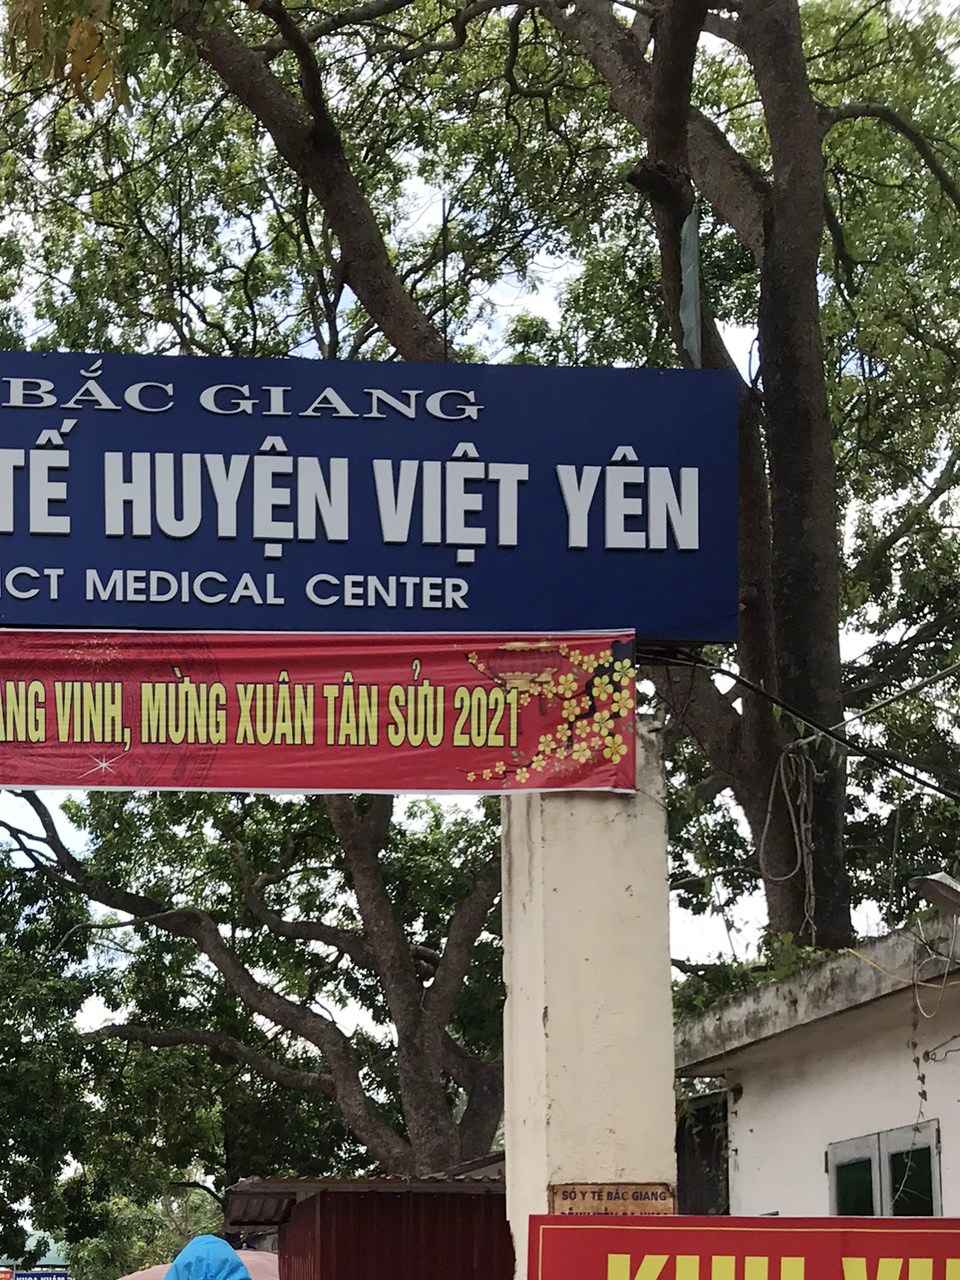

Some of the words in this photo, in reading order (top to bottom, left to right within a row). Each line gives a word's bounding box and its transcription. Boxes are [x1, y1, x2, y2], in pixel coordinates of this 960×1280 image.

[2, 359, 174, 413] BẮC
[199, 382, 485, 421] GIANG
[104, 436, 349, 561] HUYỆN
[373, 442, 530, 564] VIỆT
[556, 445, 700, 551] YÊN
[85, 568, 285, 605] MEDICAL
[305, 573, 470, 610] CENTER
[53, 681, 132, 752] VINH,
[140, 666, 227, 745] MỪNG
[235, 670, 315, 746] XUÂN
[322, 671, 379, 746] TÂN
[387, 658, 445, 747] SỬU
[452, 686, 519, 748] 2021
[580, 1191, 588, 1200] Y
[632, 1191, 667, 1201] GIANG
